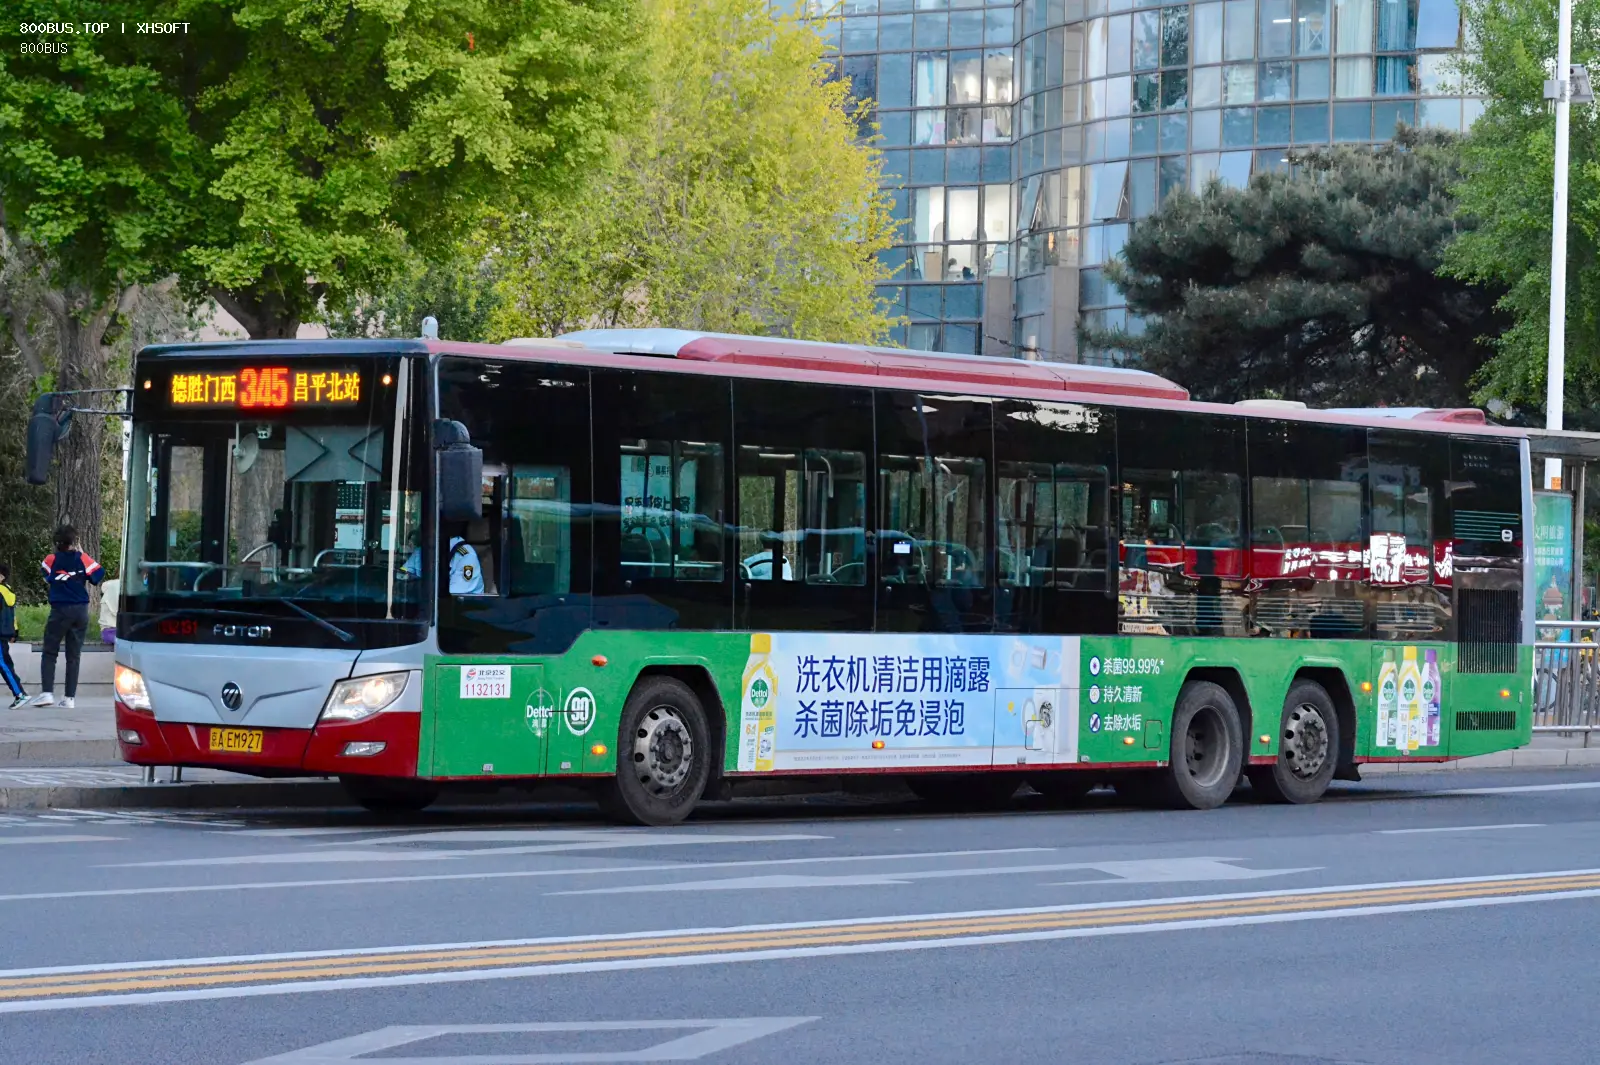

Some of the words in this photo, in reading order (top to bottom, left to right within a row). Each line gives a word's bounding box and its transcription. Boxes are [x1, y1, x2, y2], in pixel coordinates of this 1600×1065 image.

[171, 374, 236, 403] 德胜门西
[239, 367, 289, 408] 345
[293, 372, 361, 402] 昌平北站
[795, 654, 990, 693] 洗衣机清洁用滴露
[465, 683, 505, 697] 1132131
[1103, 685, 1143, 703] 持久清新
[526, 704, 553, 718] Dettol
[793, 699, 965, 738] 杀菌除垢免浸泡
[1103, 713, 1142, 731] 去除水垢
